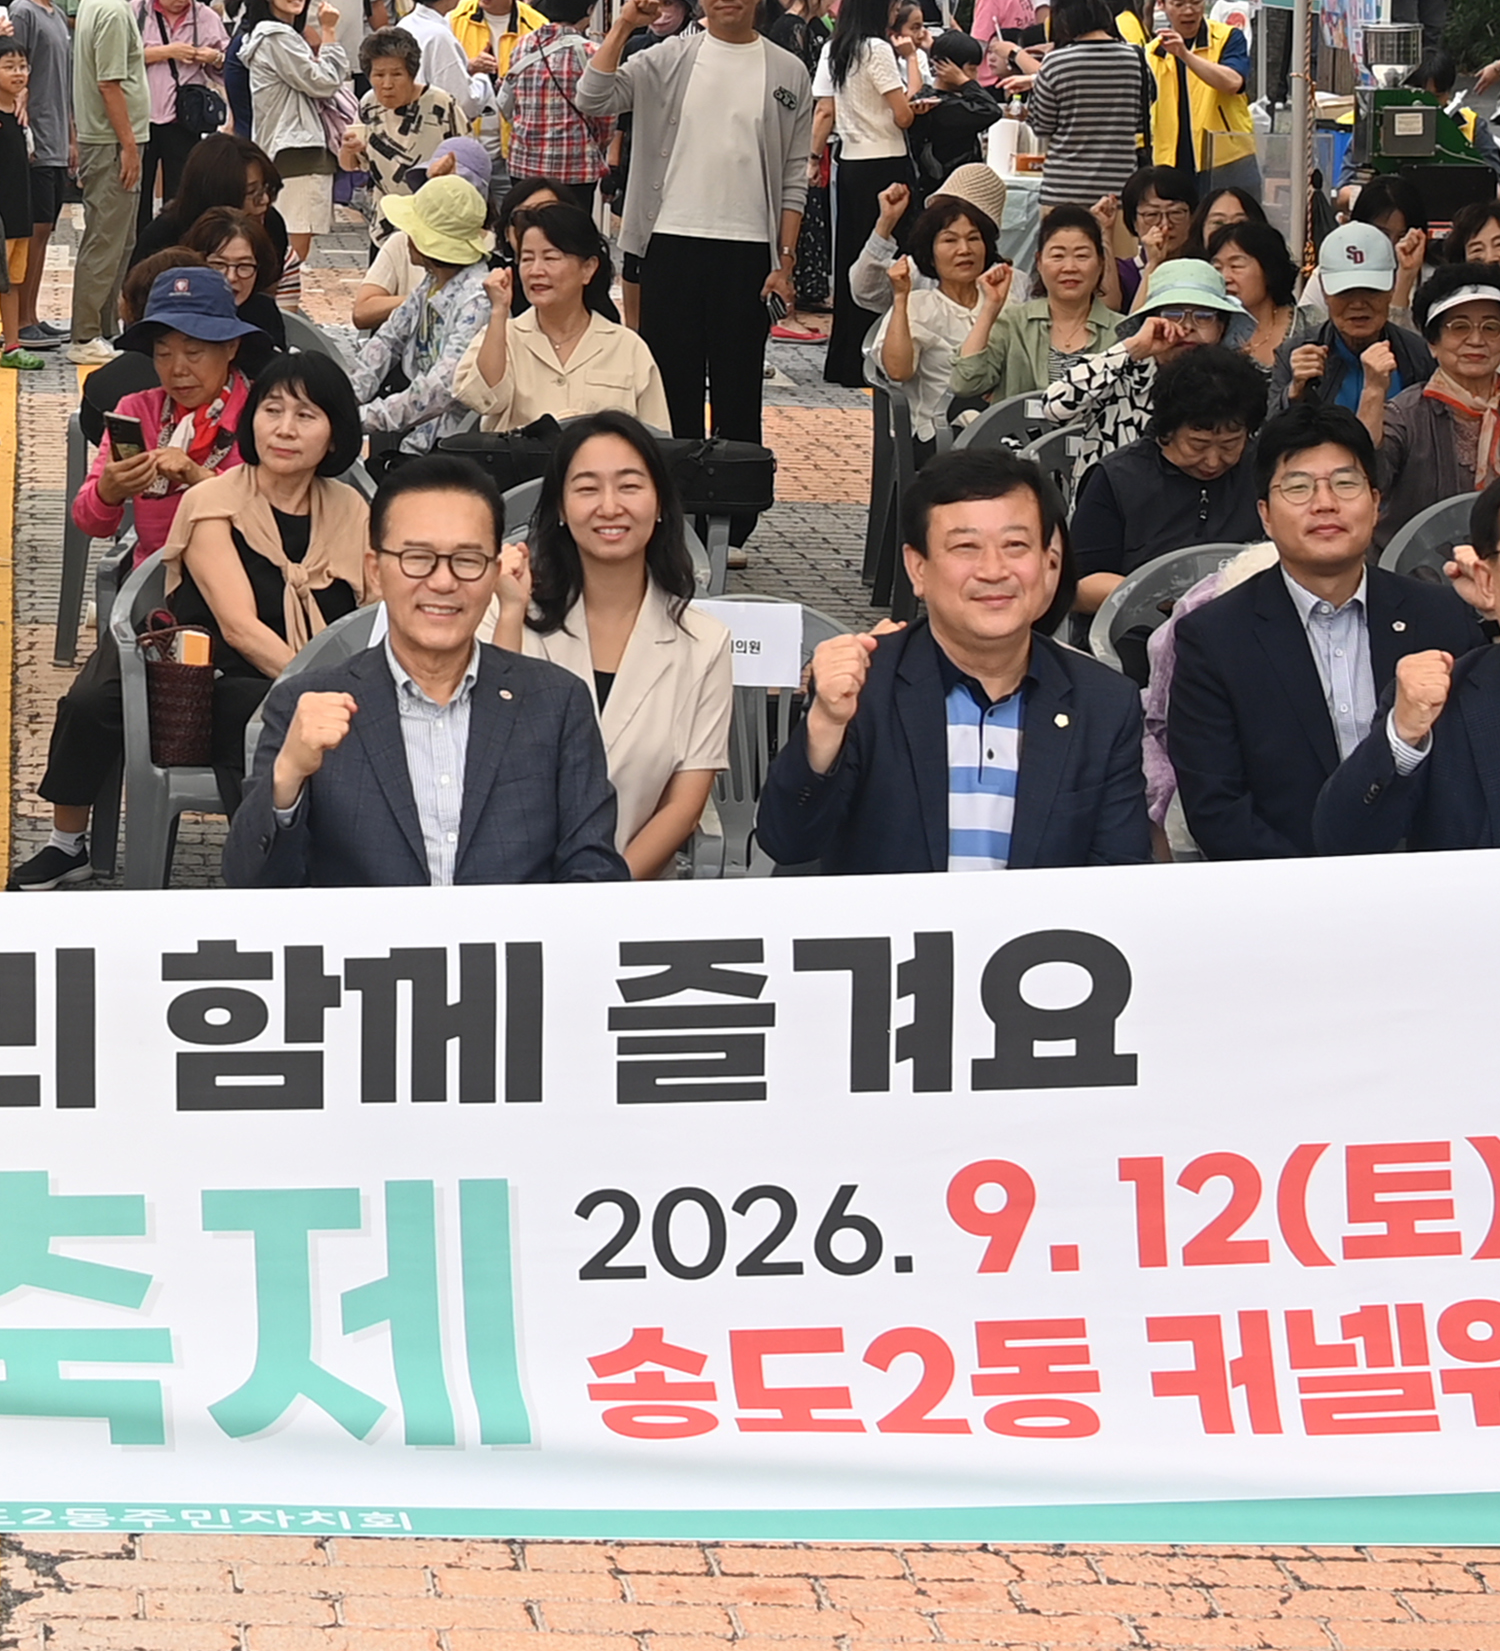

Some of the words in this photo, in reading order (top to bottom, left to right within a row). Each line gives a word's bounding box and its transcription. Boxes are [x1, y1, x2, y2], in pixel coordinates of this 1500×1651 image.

[161, 939, 543, 1112] 함께
[607, 929, 1138, 1105] 즐겨요
[574, 1184, 913, 1281] 2026.
[946, 1158, 1080, 1274] 9.
[587, 1317, 1102, 1440] 송도2동
